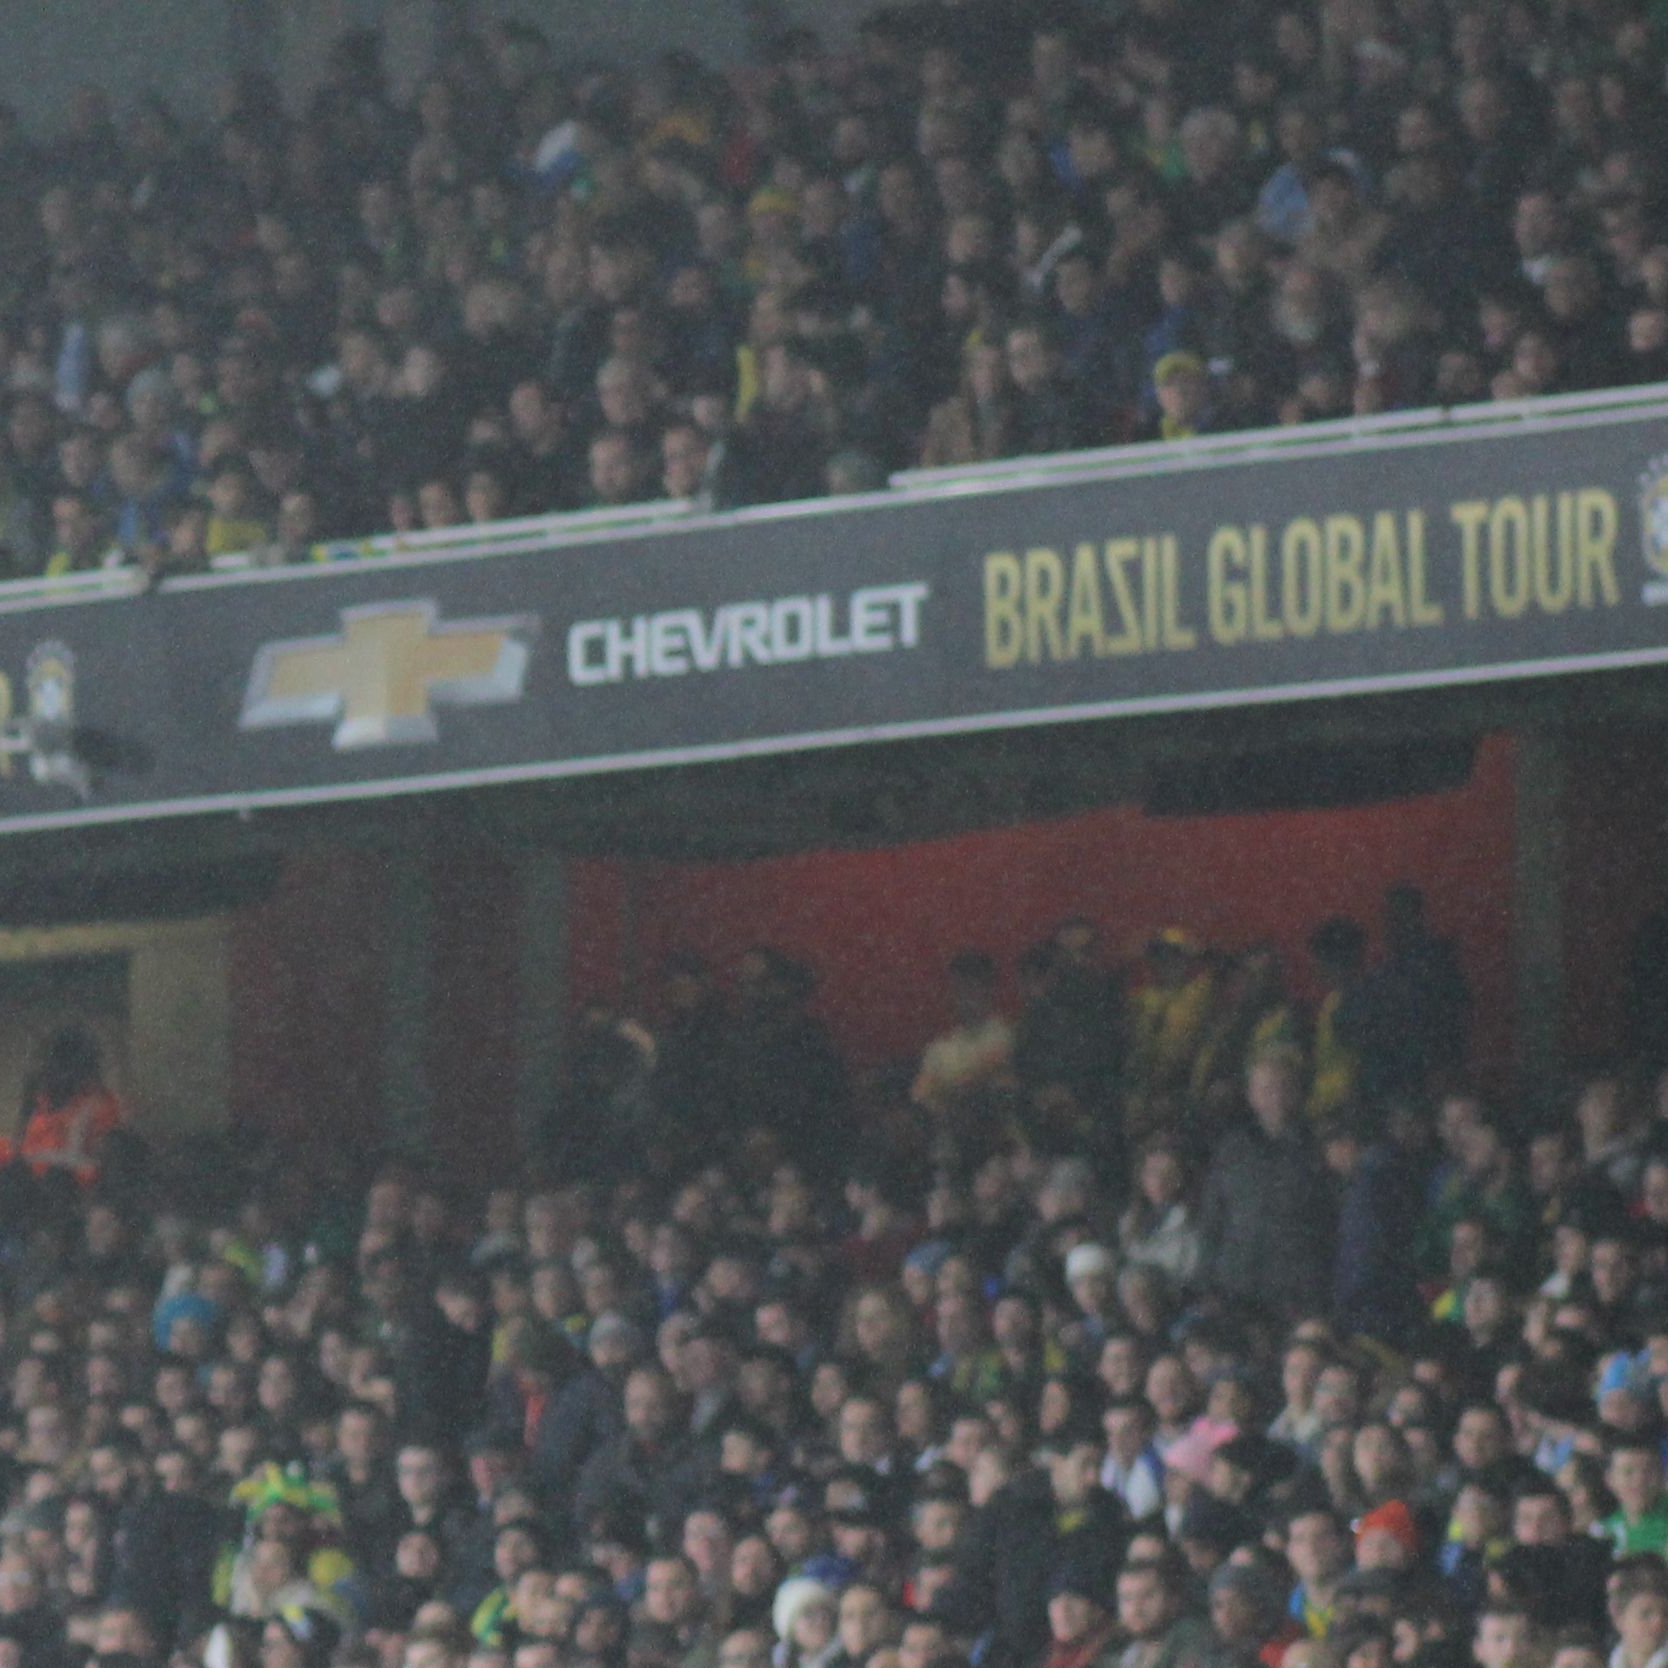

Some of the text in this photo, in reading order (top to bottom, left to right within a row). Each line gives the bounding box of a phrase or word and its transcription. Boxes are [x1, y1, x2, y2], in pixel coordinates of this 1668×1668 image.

[568, 580, 930, 687] CHEVROLET
[984, 487, 1620, 669] BRASIL GLOBAL TOUR
